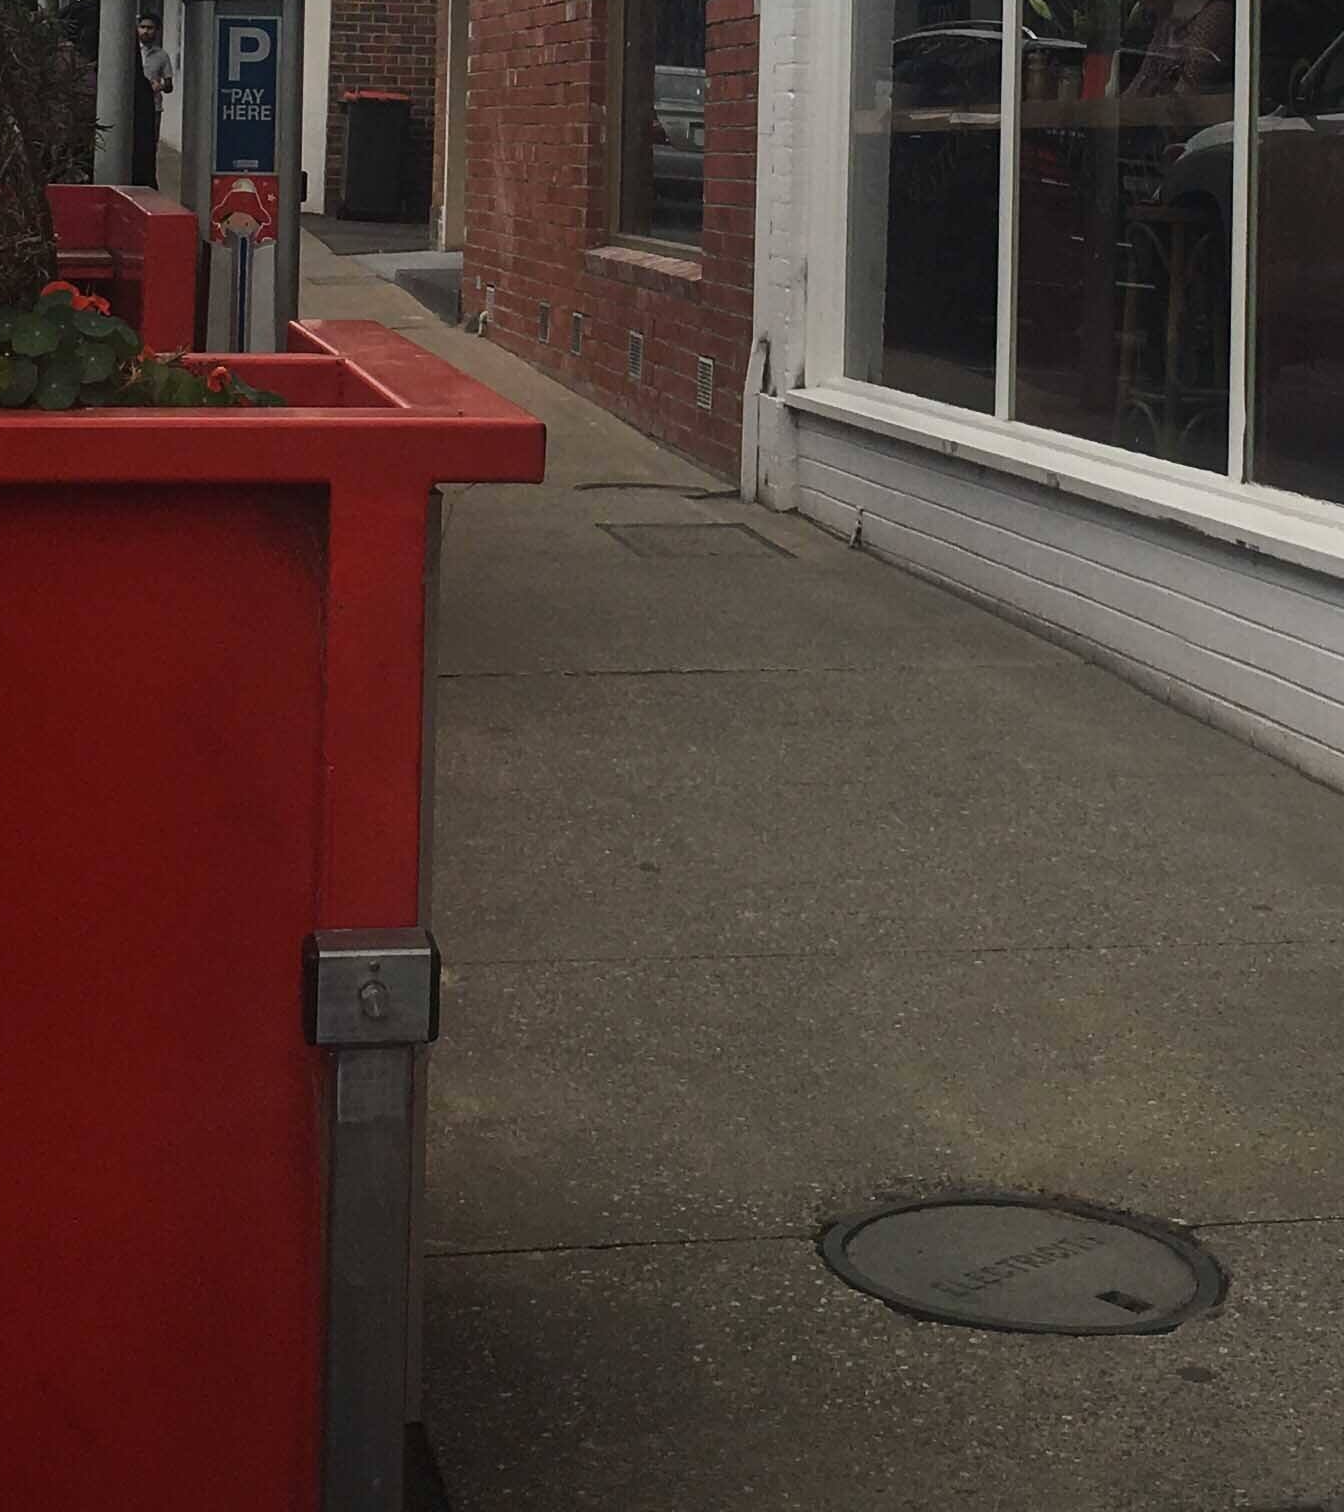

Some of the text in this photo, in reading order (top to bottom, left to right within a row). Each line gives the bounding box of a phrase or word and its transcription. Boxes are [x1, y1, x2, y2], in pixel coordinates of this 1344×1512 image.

[228, 26, 271, 81] P
[231, 88, 265, 105] PAY
[222, 104, 272, 121] HERE
